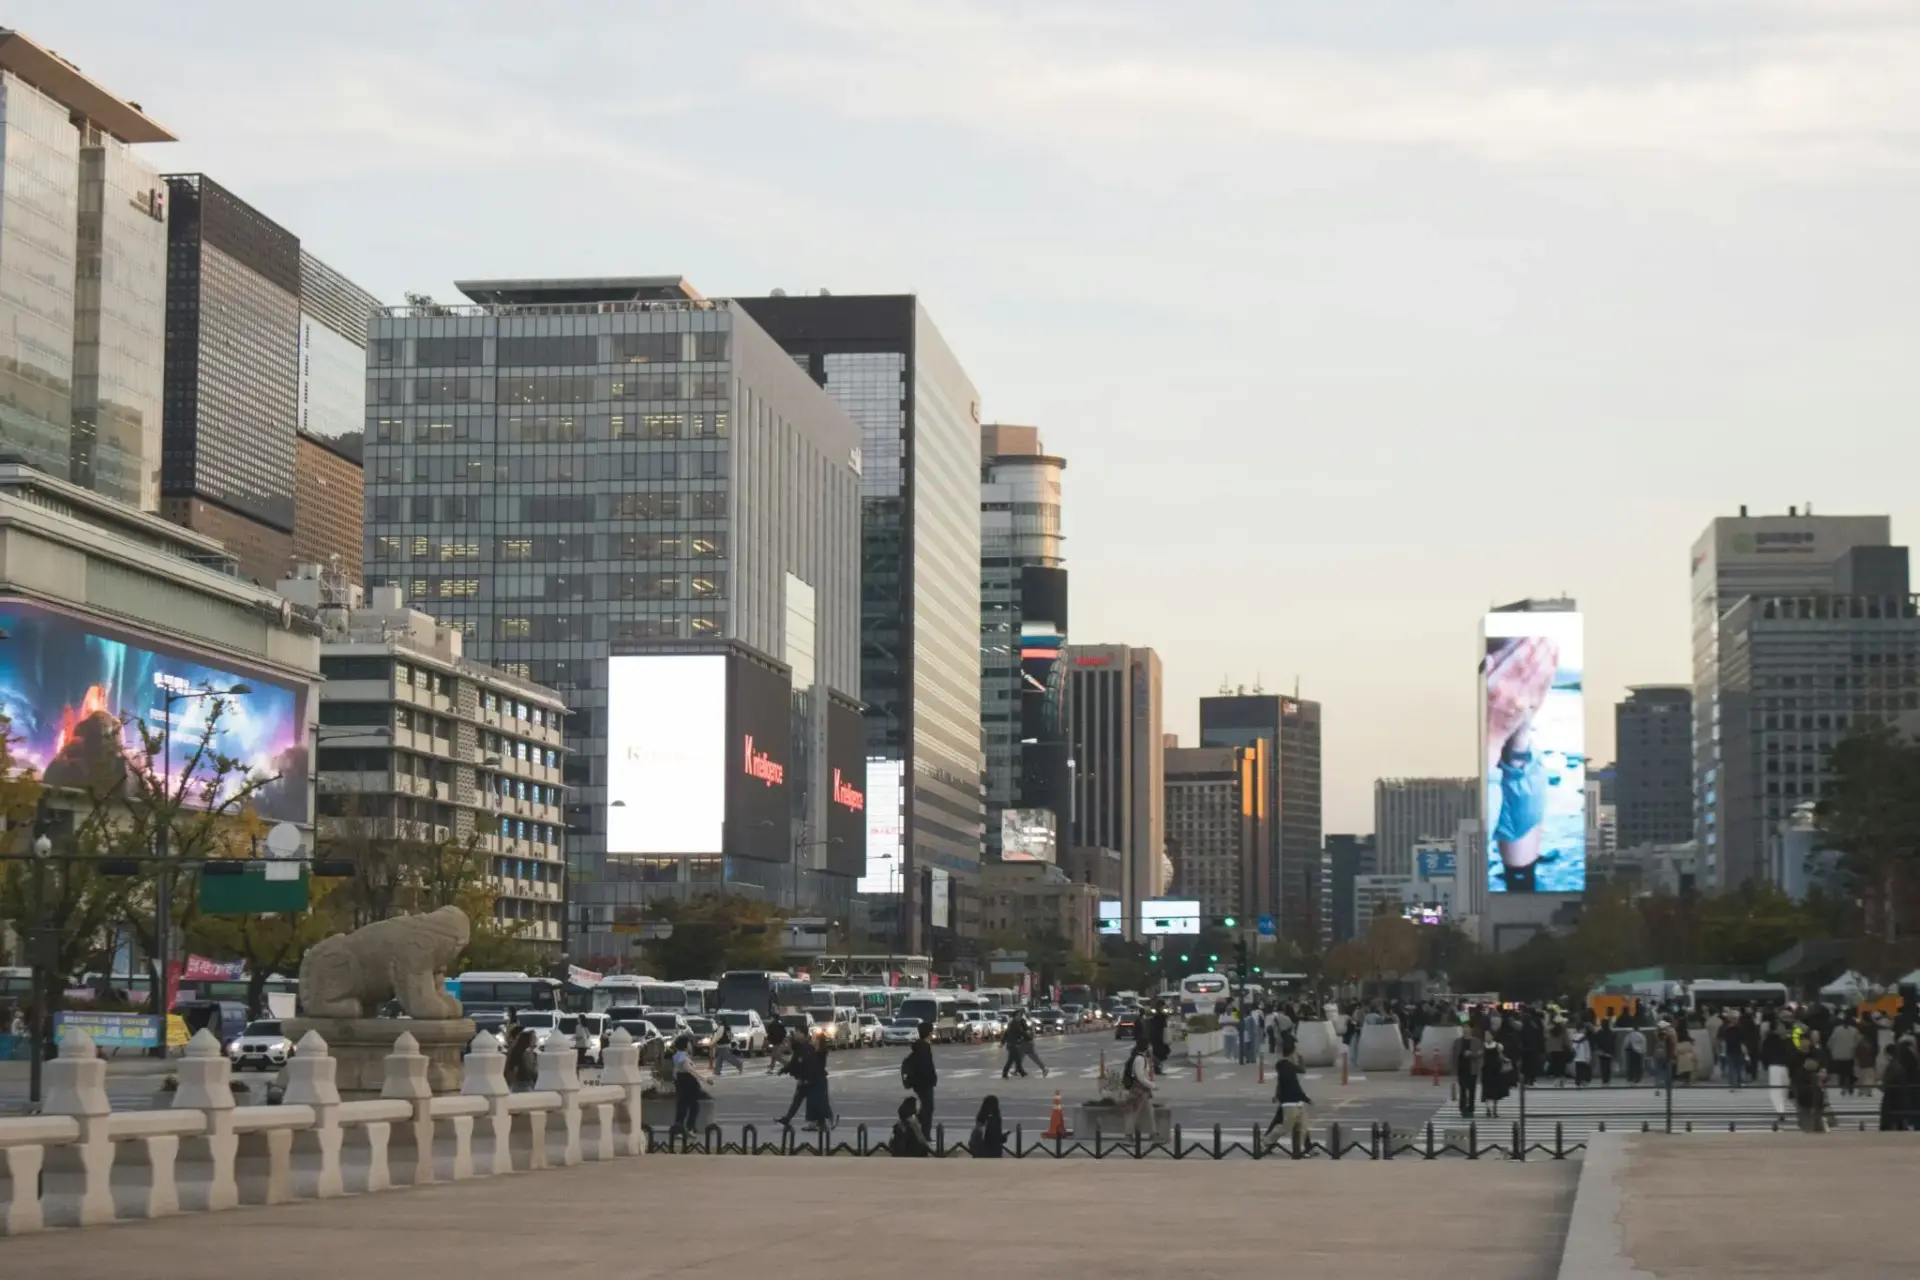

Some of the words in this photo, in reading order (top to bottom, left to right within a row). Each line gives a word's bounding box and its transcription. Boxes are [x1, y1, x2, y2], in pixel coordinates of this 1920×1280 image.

[745, 734, 753, 775] K
[753, 747, 783, 787] intelligence
[834, 768, 841, 803] K
